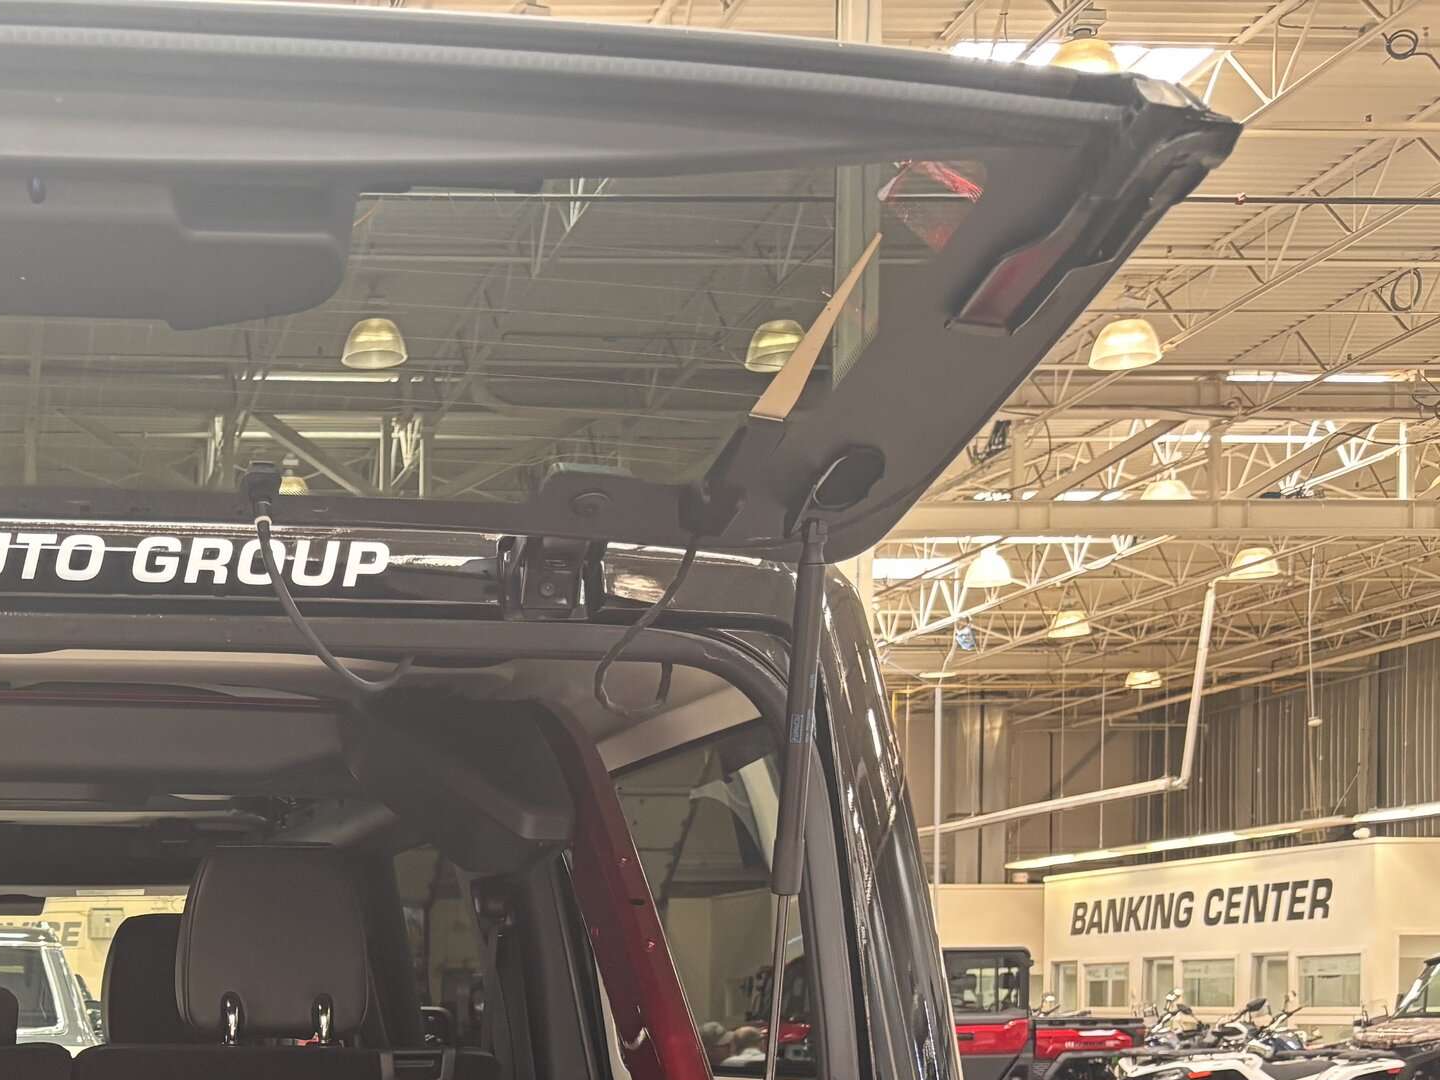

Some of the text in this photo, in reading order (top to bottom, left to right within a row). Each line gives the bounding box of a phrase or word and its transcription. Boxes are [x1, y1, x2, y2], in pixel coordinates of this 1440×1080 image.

[132, 536, 391, 588] GROUP
[1070, 878, 1333, 935] BANKING CENTER
